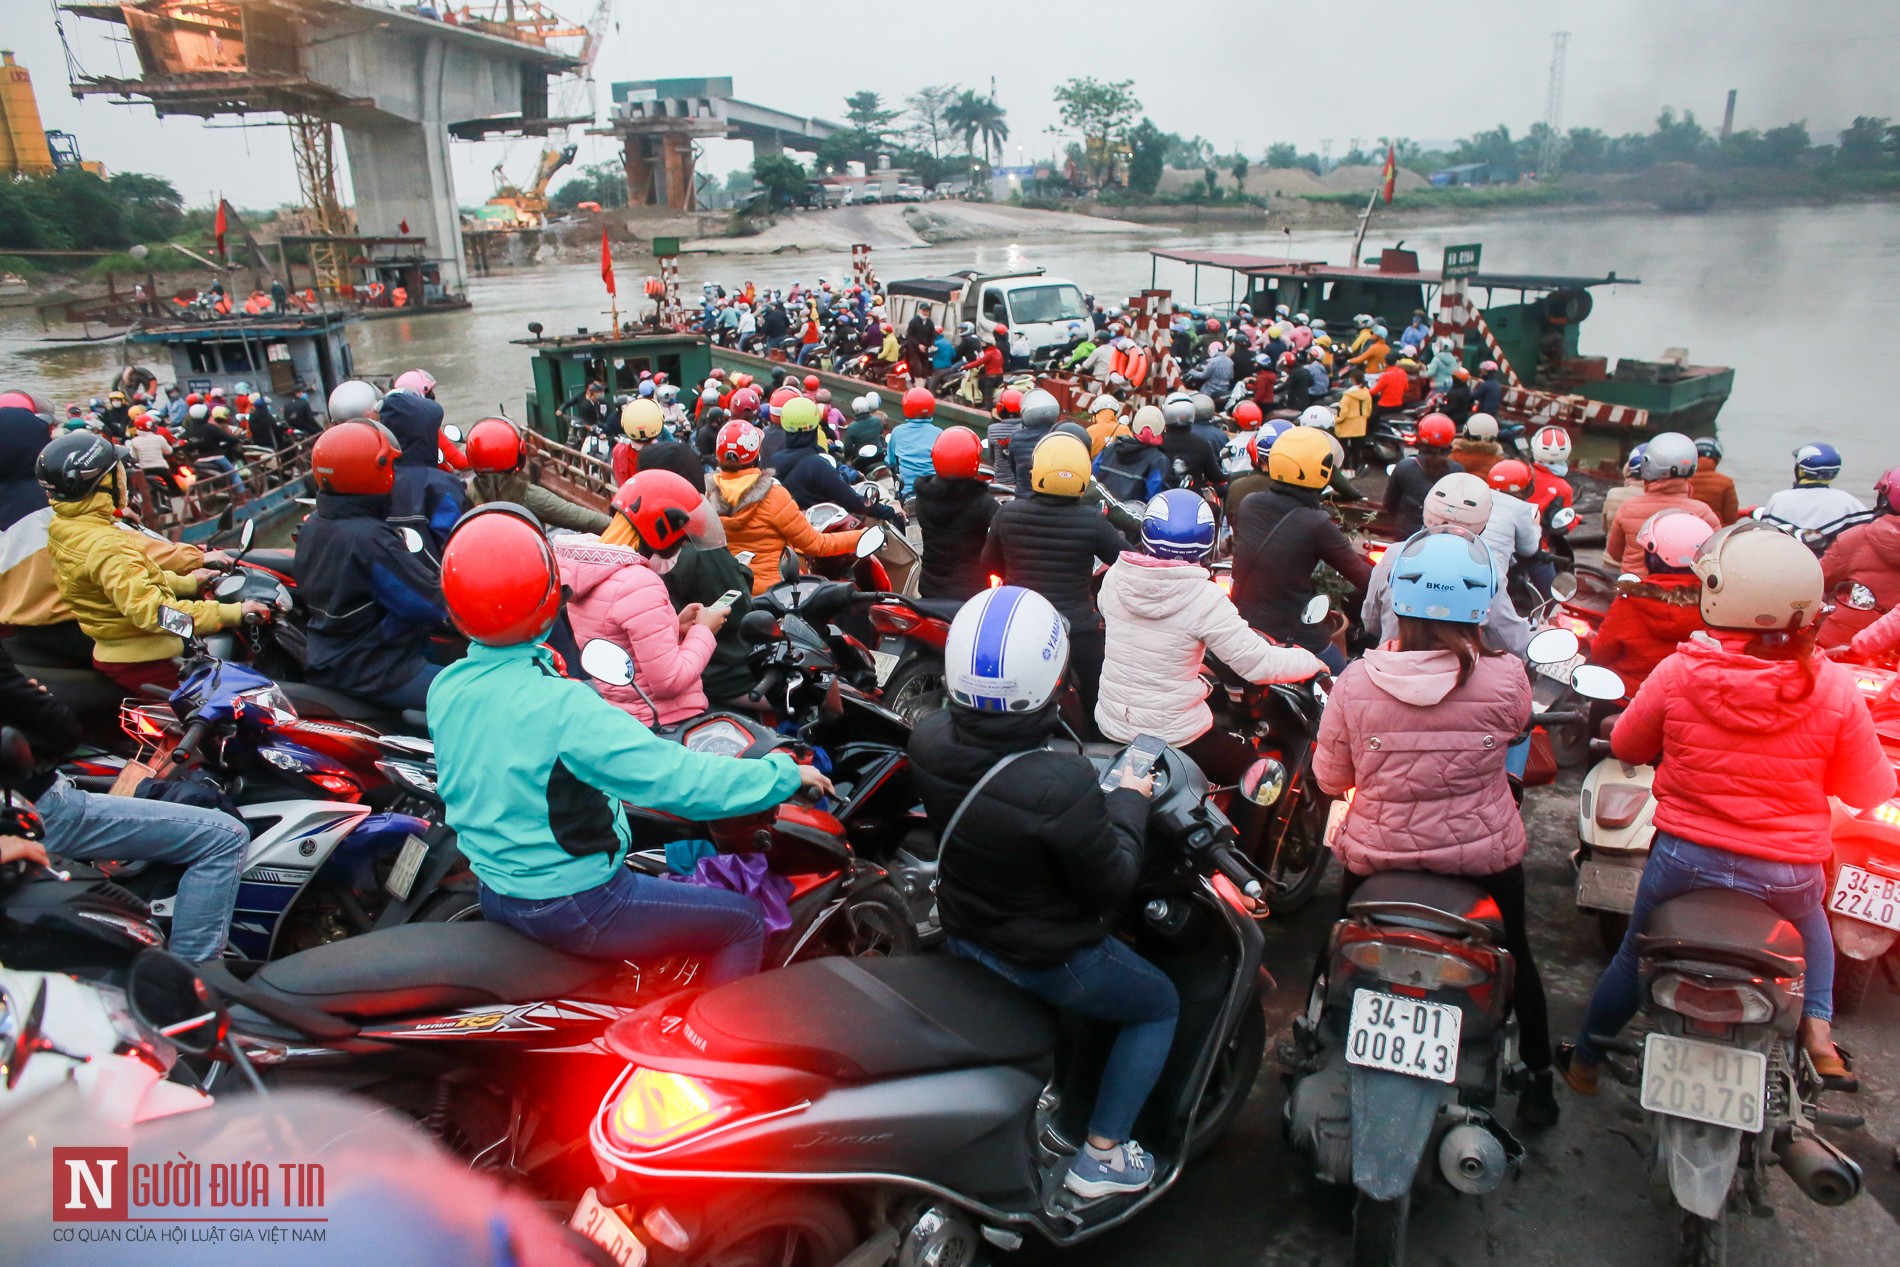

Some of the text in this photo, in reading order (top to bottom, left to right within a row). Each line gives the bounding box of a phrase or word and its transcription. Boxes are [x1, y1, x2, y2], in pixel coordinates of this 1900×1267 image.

[1367, 998, 1442, 1039] 34-D1
[1354, 1028, 1448, 1074] 008.43
[1648, 1074, 1756, 1125] 203.76
